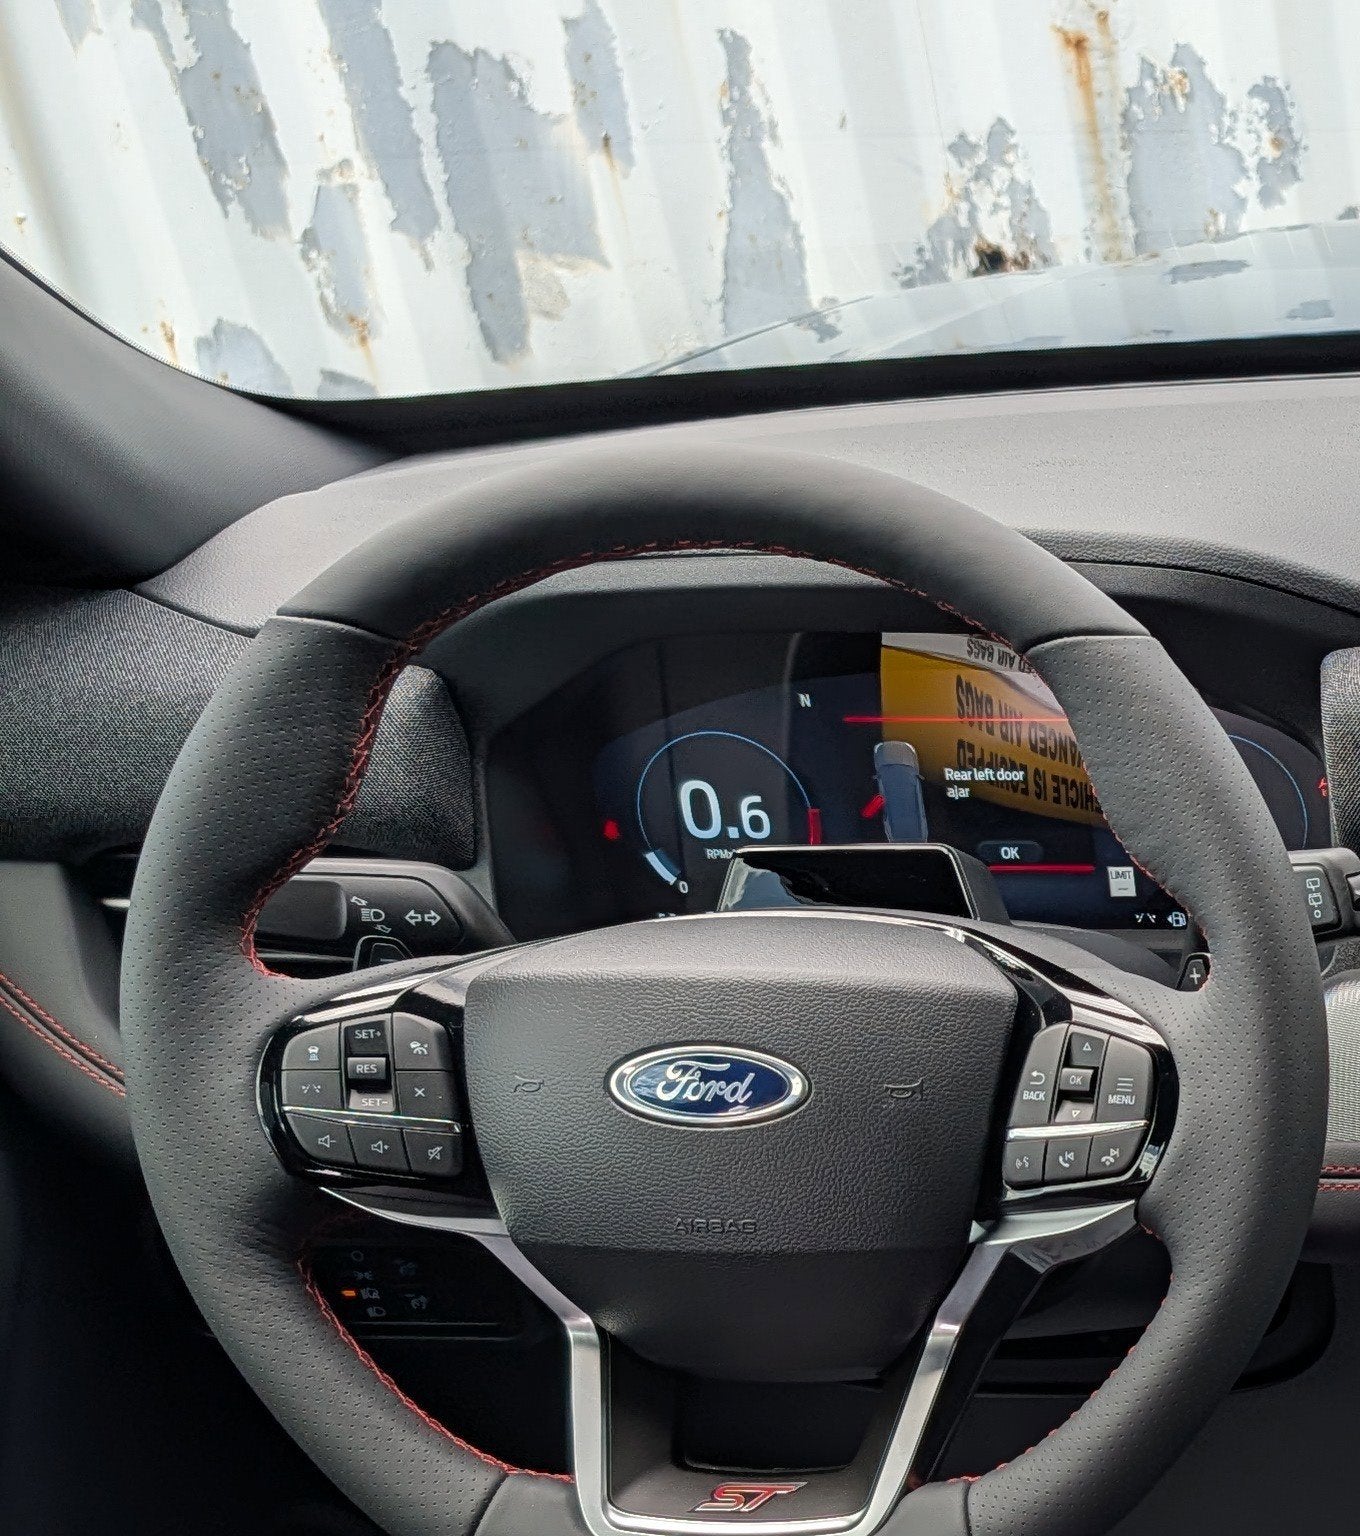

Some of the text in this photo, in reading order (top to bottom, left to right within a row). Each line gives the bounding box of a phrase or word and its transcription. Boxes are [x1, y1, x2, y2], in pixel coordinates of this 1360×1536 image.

[798, 692, 812, 708] N
[944, 768, 1025, 781] Rear left door
[947, 785, 970, 800] ajar
[680, 779, 771, 839] 0.6
[1000, 846, 1021, 860] OK
[1109, 869, 1132, 881] LIMIT
[355, 1029, 381, 1039] SET+
[356, 1064, 377, 1074] RES
[656, 1060, 756, 1104] Ford
[1069, 1075, 1082, 1085] OK
[1022, 1091, 1046, 1101] BACK
[1107, 1095, 1135, 1105] MENU
[673, 1217, 758, 1235] AIRBAG
[687, 1481, 808, 1512] ST
